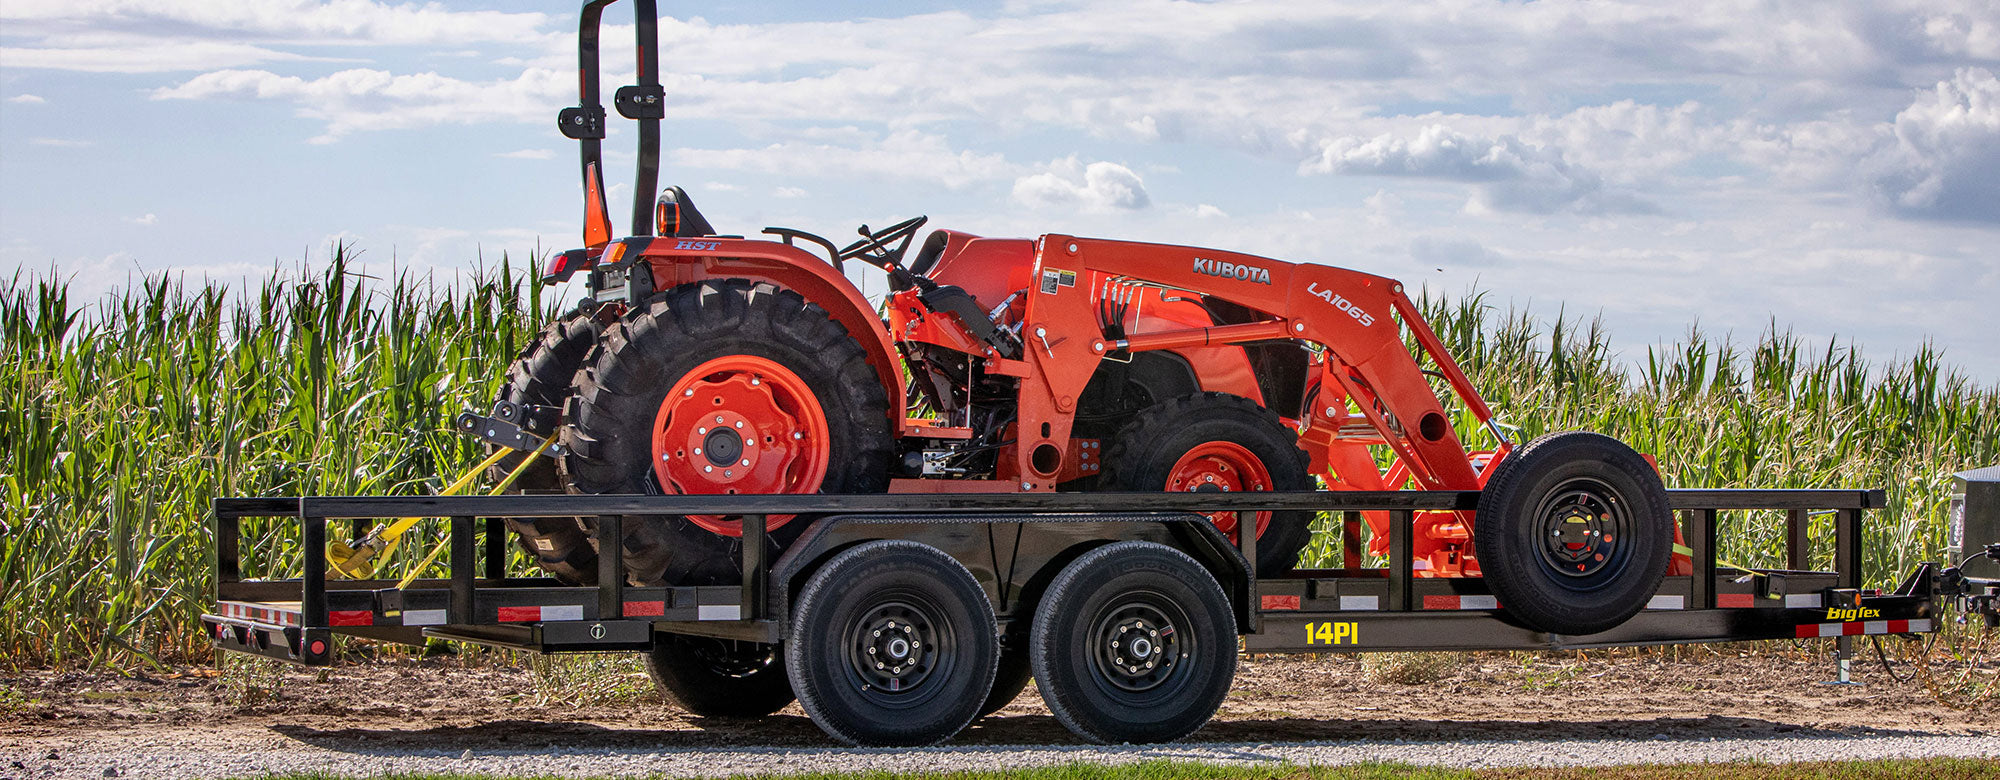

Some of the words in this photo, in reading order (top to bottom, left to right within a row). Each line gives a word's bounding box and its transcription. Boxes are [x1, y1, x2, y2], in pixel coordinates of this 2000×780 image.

[674, 241, 721, 251] HST
[1193, 257, 1271, 285] KUBOTA
[1307, 282, 1376, 327] LA1065
[1305, 622, 1358, 645] 14PI
